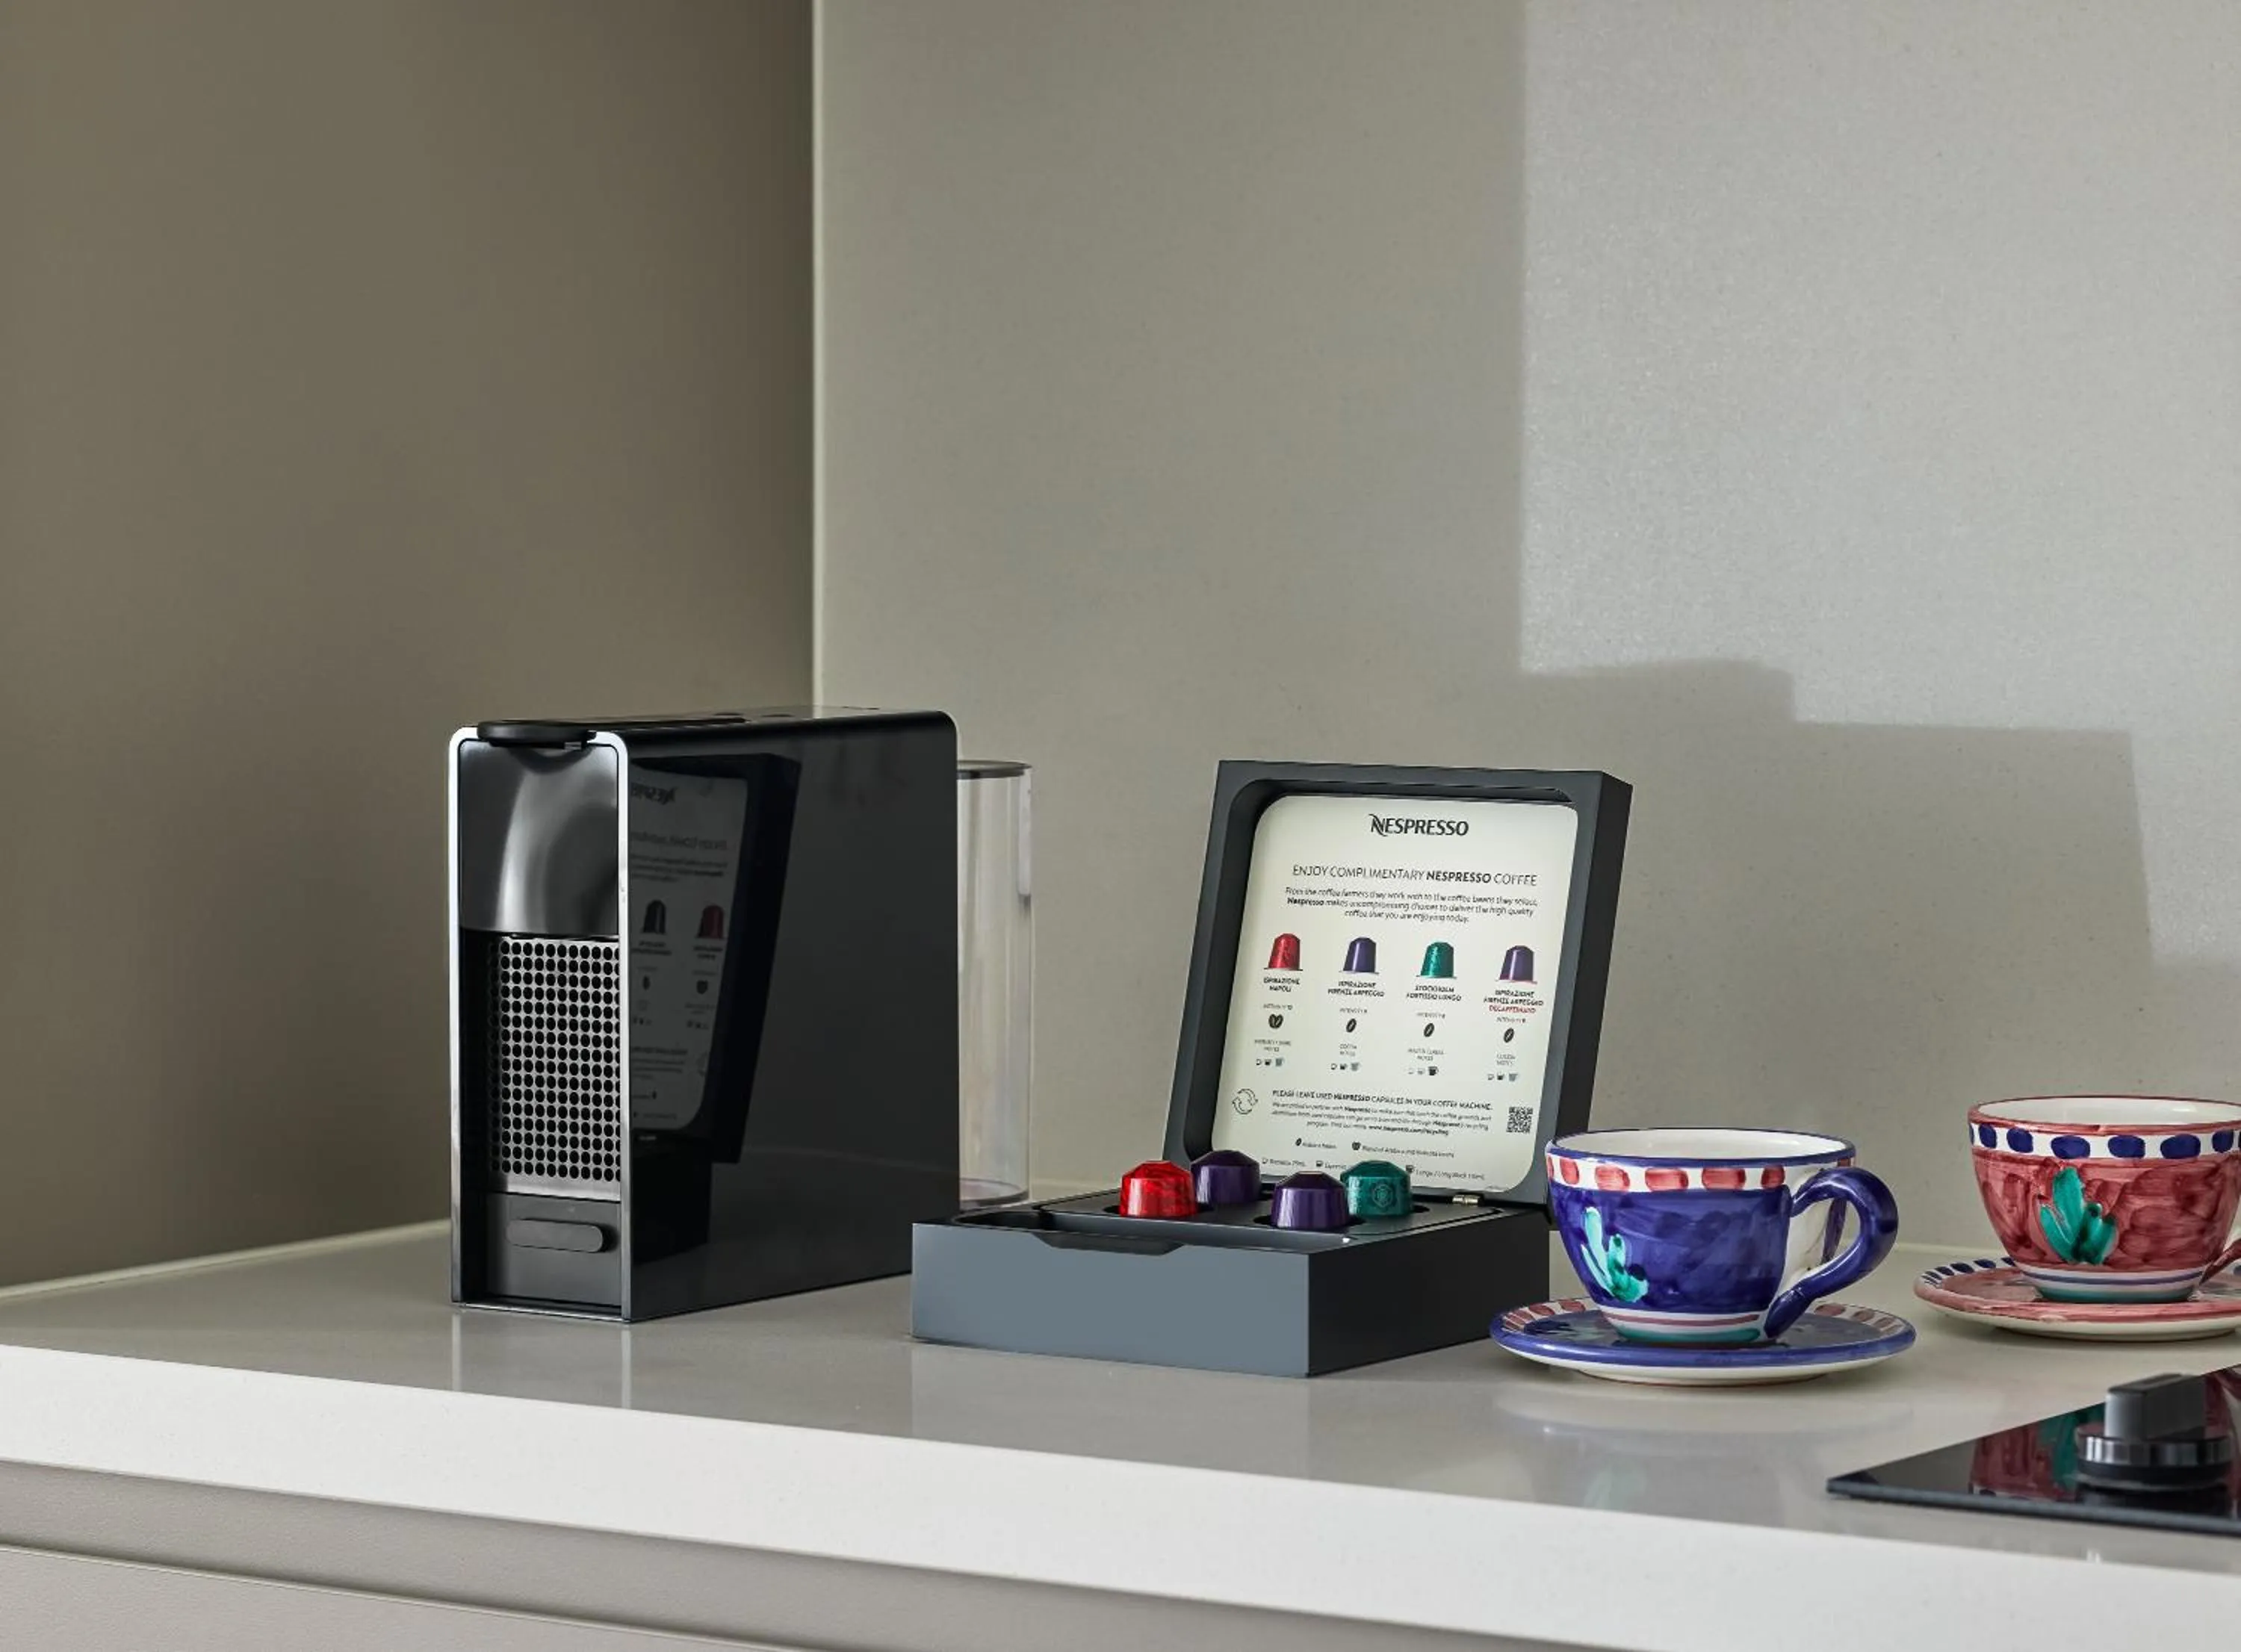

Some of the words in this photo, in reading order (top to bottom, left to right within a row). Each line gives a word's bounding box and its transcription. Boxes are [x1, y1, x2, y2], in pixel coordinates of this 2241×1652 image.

[1369, 813, 1469, 836] NESPRESSO
[1292, 864, 1328, 876] ENJOY
[1330, 866, 1425, 881] COMPLIMENTARY
[1426, 870, 1491, 884] NESPRESSO
[1493, 873, 1537, 886] COFFEE
[1285, 886, 1304, 895] From
[1305, 886, 1316, 895] the
[1318, 887, 1340, 897] coffee
[1447, 894, 1471, 903] coffee
[1286, 896, 1324, 907] Nespresso
[1326, 898, 1348, 907] makes
[1507, 907, 1534, 917] quality
[1344, 909, 1367, 918] coffee
[1385, 911, 1398, 920] you
[1333, 1093, 1371, 1102] NESPRESSO
[1413, 1098, 1432, 1106] YOUR
[1432, 1099, 1457, 1108] COFFEE
